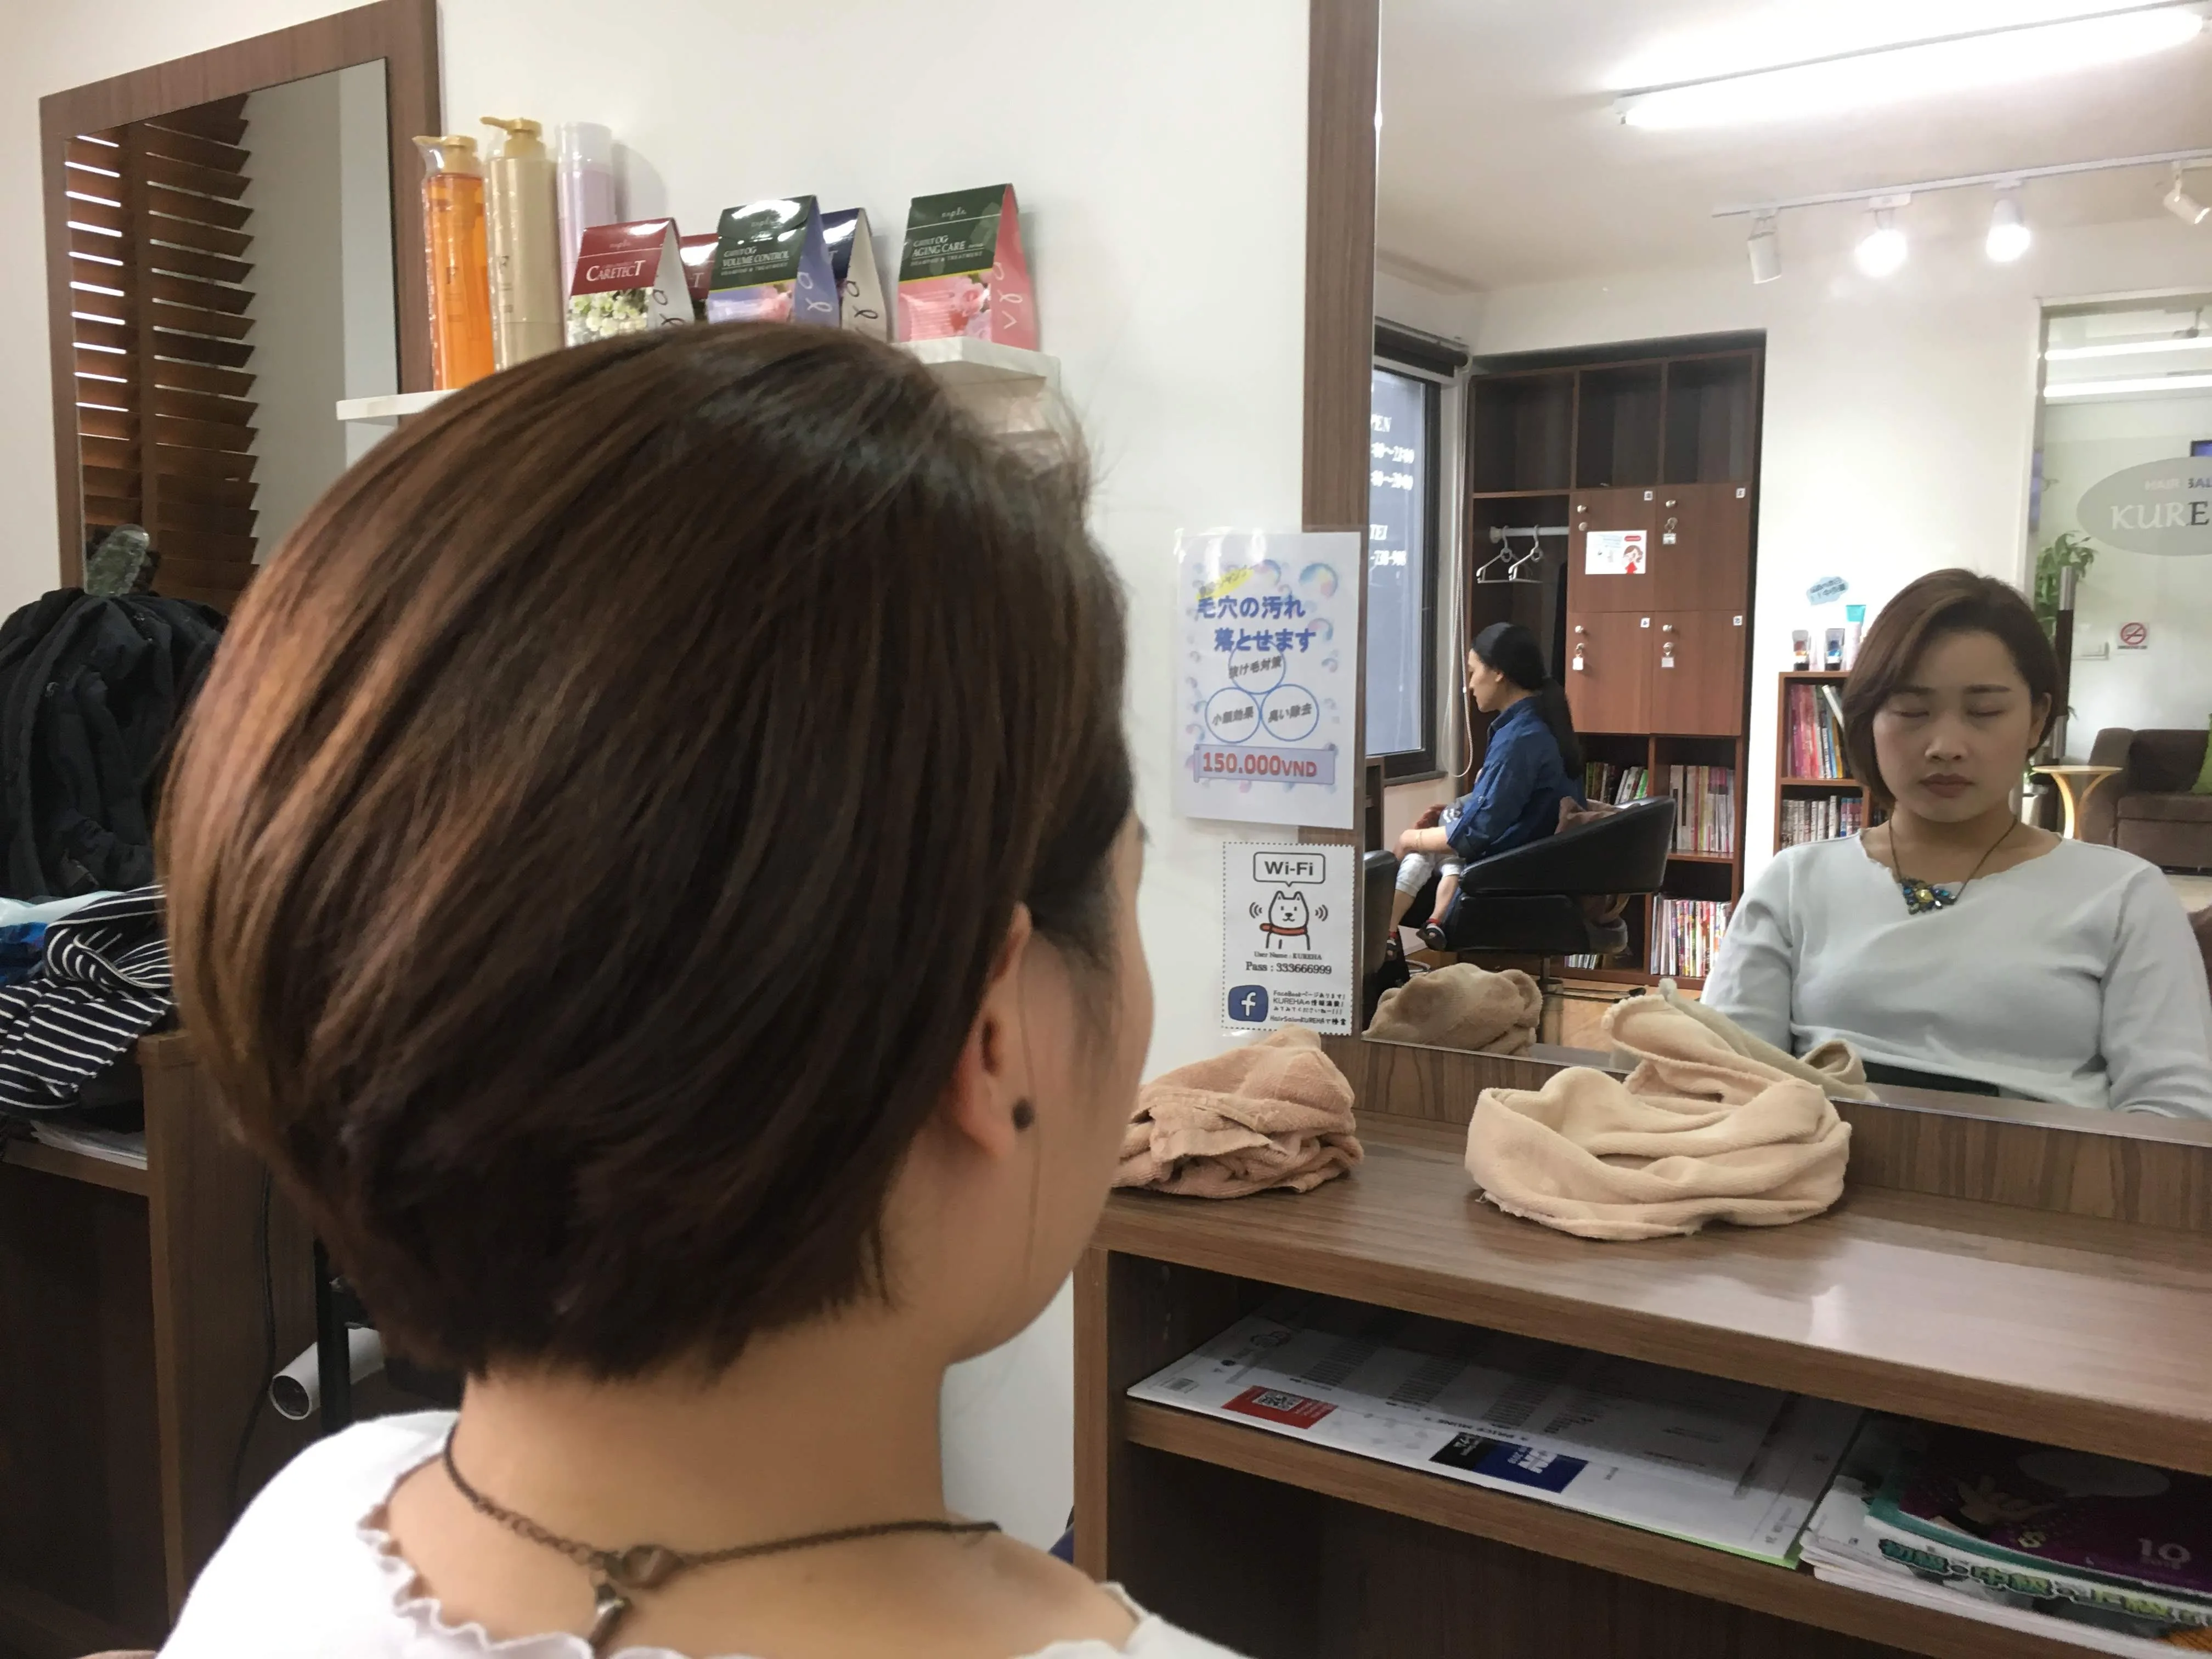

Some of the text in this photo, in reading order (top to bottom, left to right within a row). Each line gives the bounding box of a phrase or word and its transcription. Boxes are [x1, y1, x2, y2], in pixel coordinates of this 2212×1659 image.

[912, 245, 941, 257] AGING
[941, 240, 967, 252] CARE
[1198, 594, 1306, 619] 毛穴の汚れ
[1214, 628, 1316, 653] 落とせます
[1264, 861, 1313, 876] Wi-Fi
[1246, 961, 1267, 971] Pass
[1276, 963, 1332, 974] 333666999
